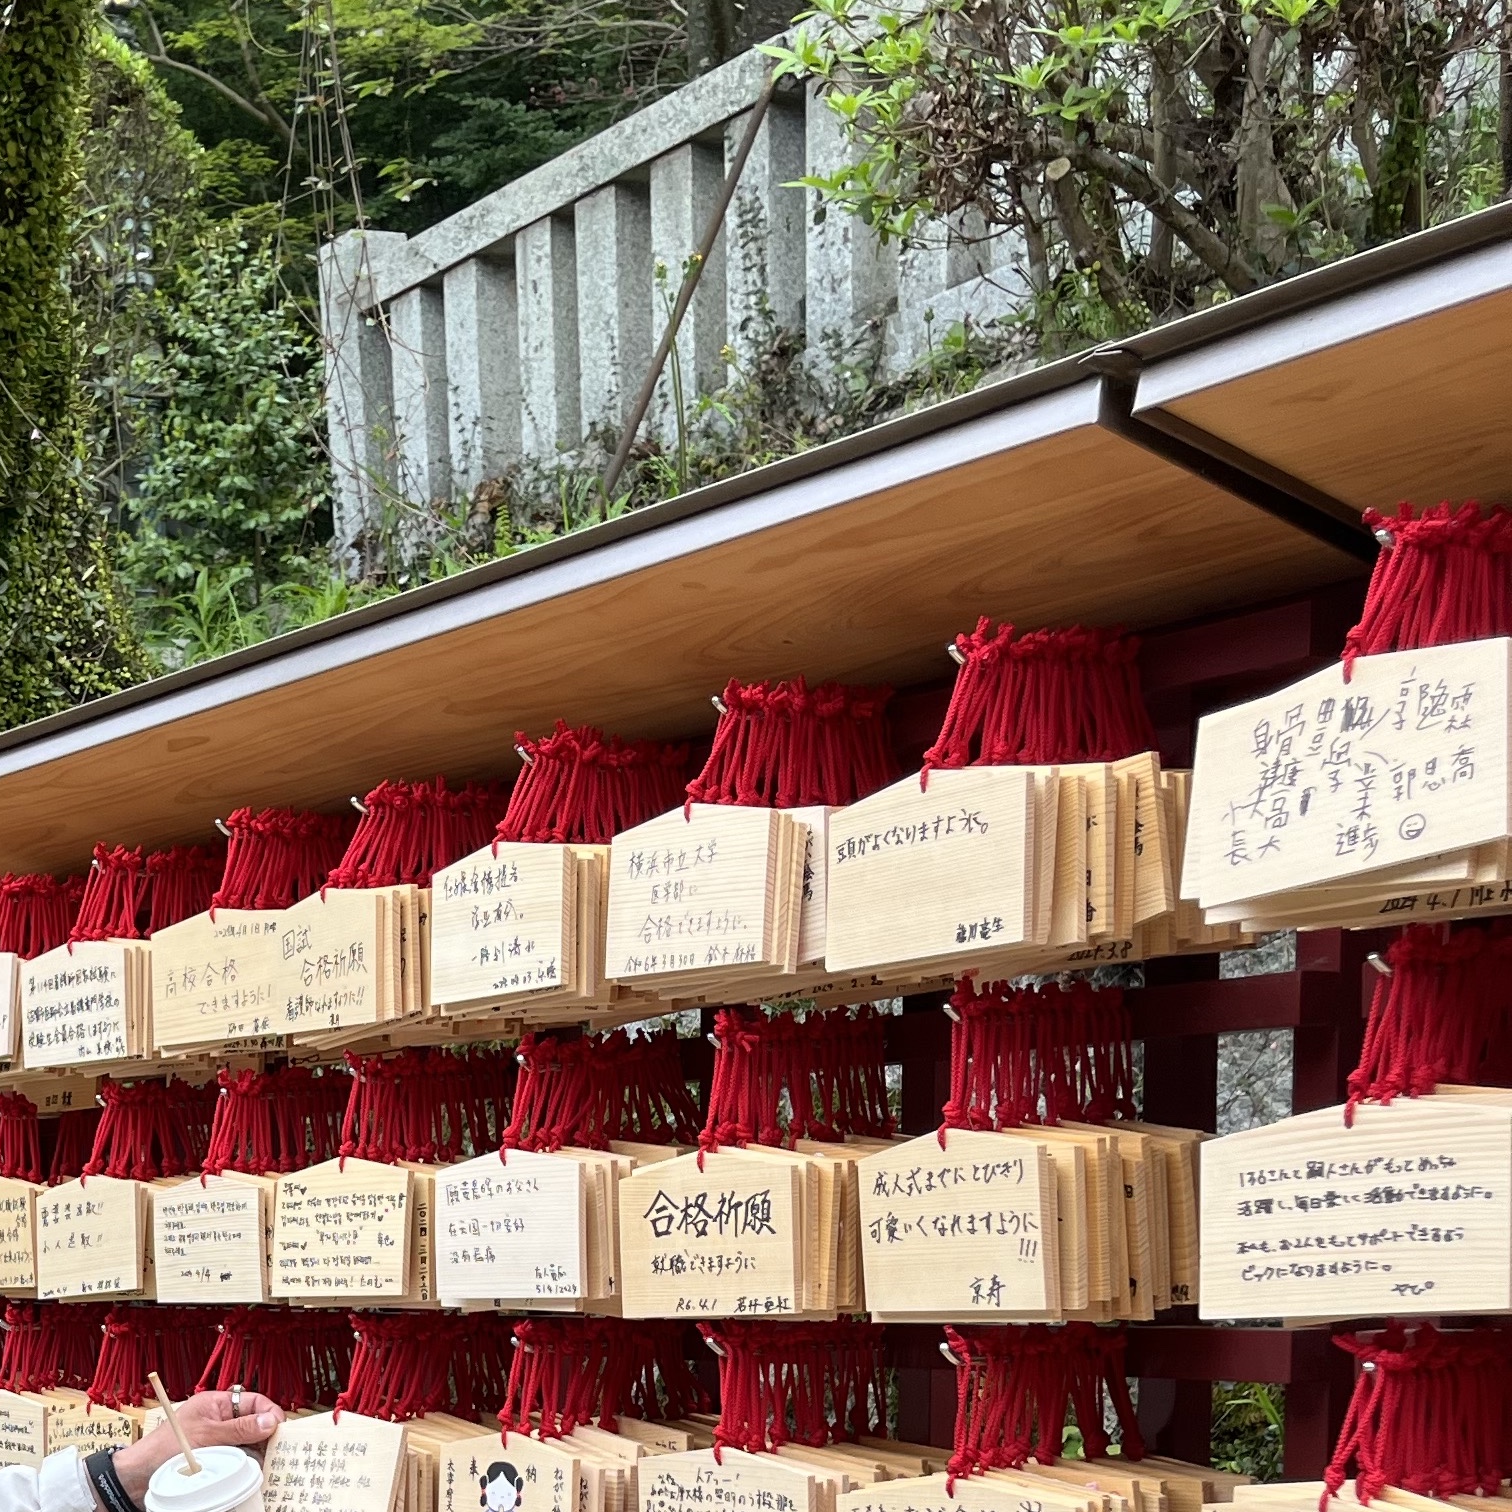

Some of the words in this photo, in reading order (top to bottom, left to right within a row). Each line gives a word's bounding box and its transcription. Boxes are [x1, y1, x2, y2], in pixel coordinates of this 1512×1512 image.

[836, 809, 989, 864] 頭がよくなりますように。
[628, 838, 718, 880] 横浜市立大学
[282, 925, 313, 960] 国試
[165, 956, 239, 998] 高校合格
[300, 942, 367, 987] 合格祈願
[643, 1189, 777, 1238] 合格祈願
[469, 1456, 479, 1481] 奉
[526, 1464, 537, 1483] 納
